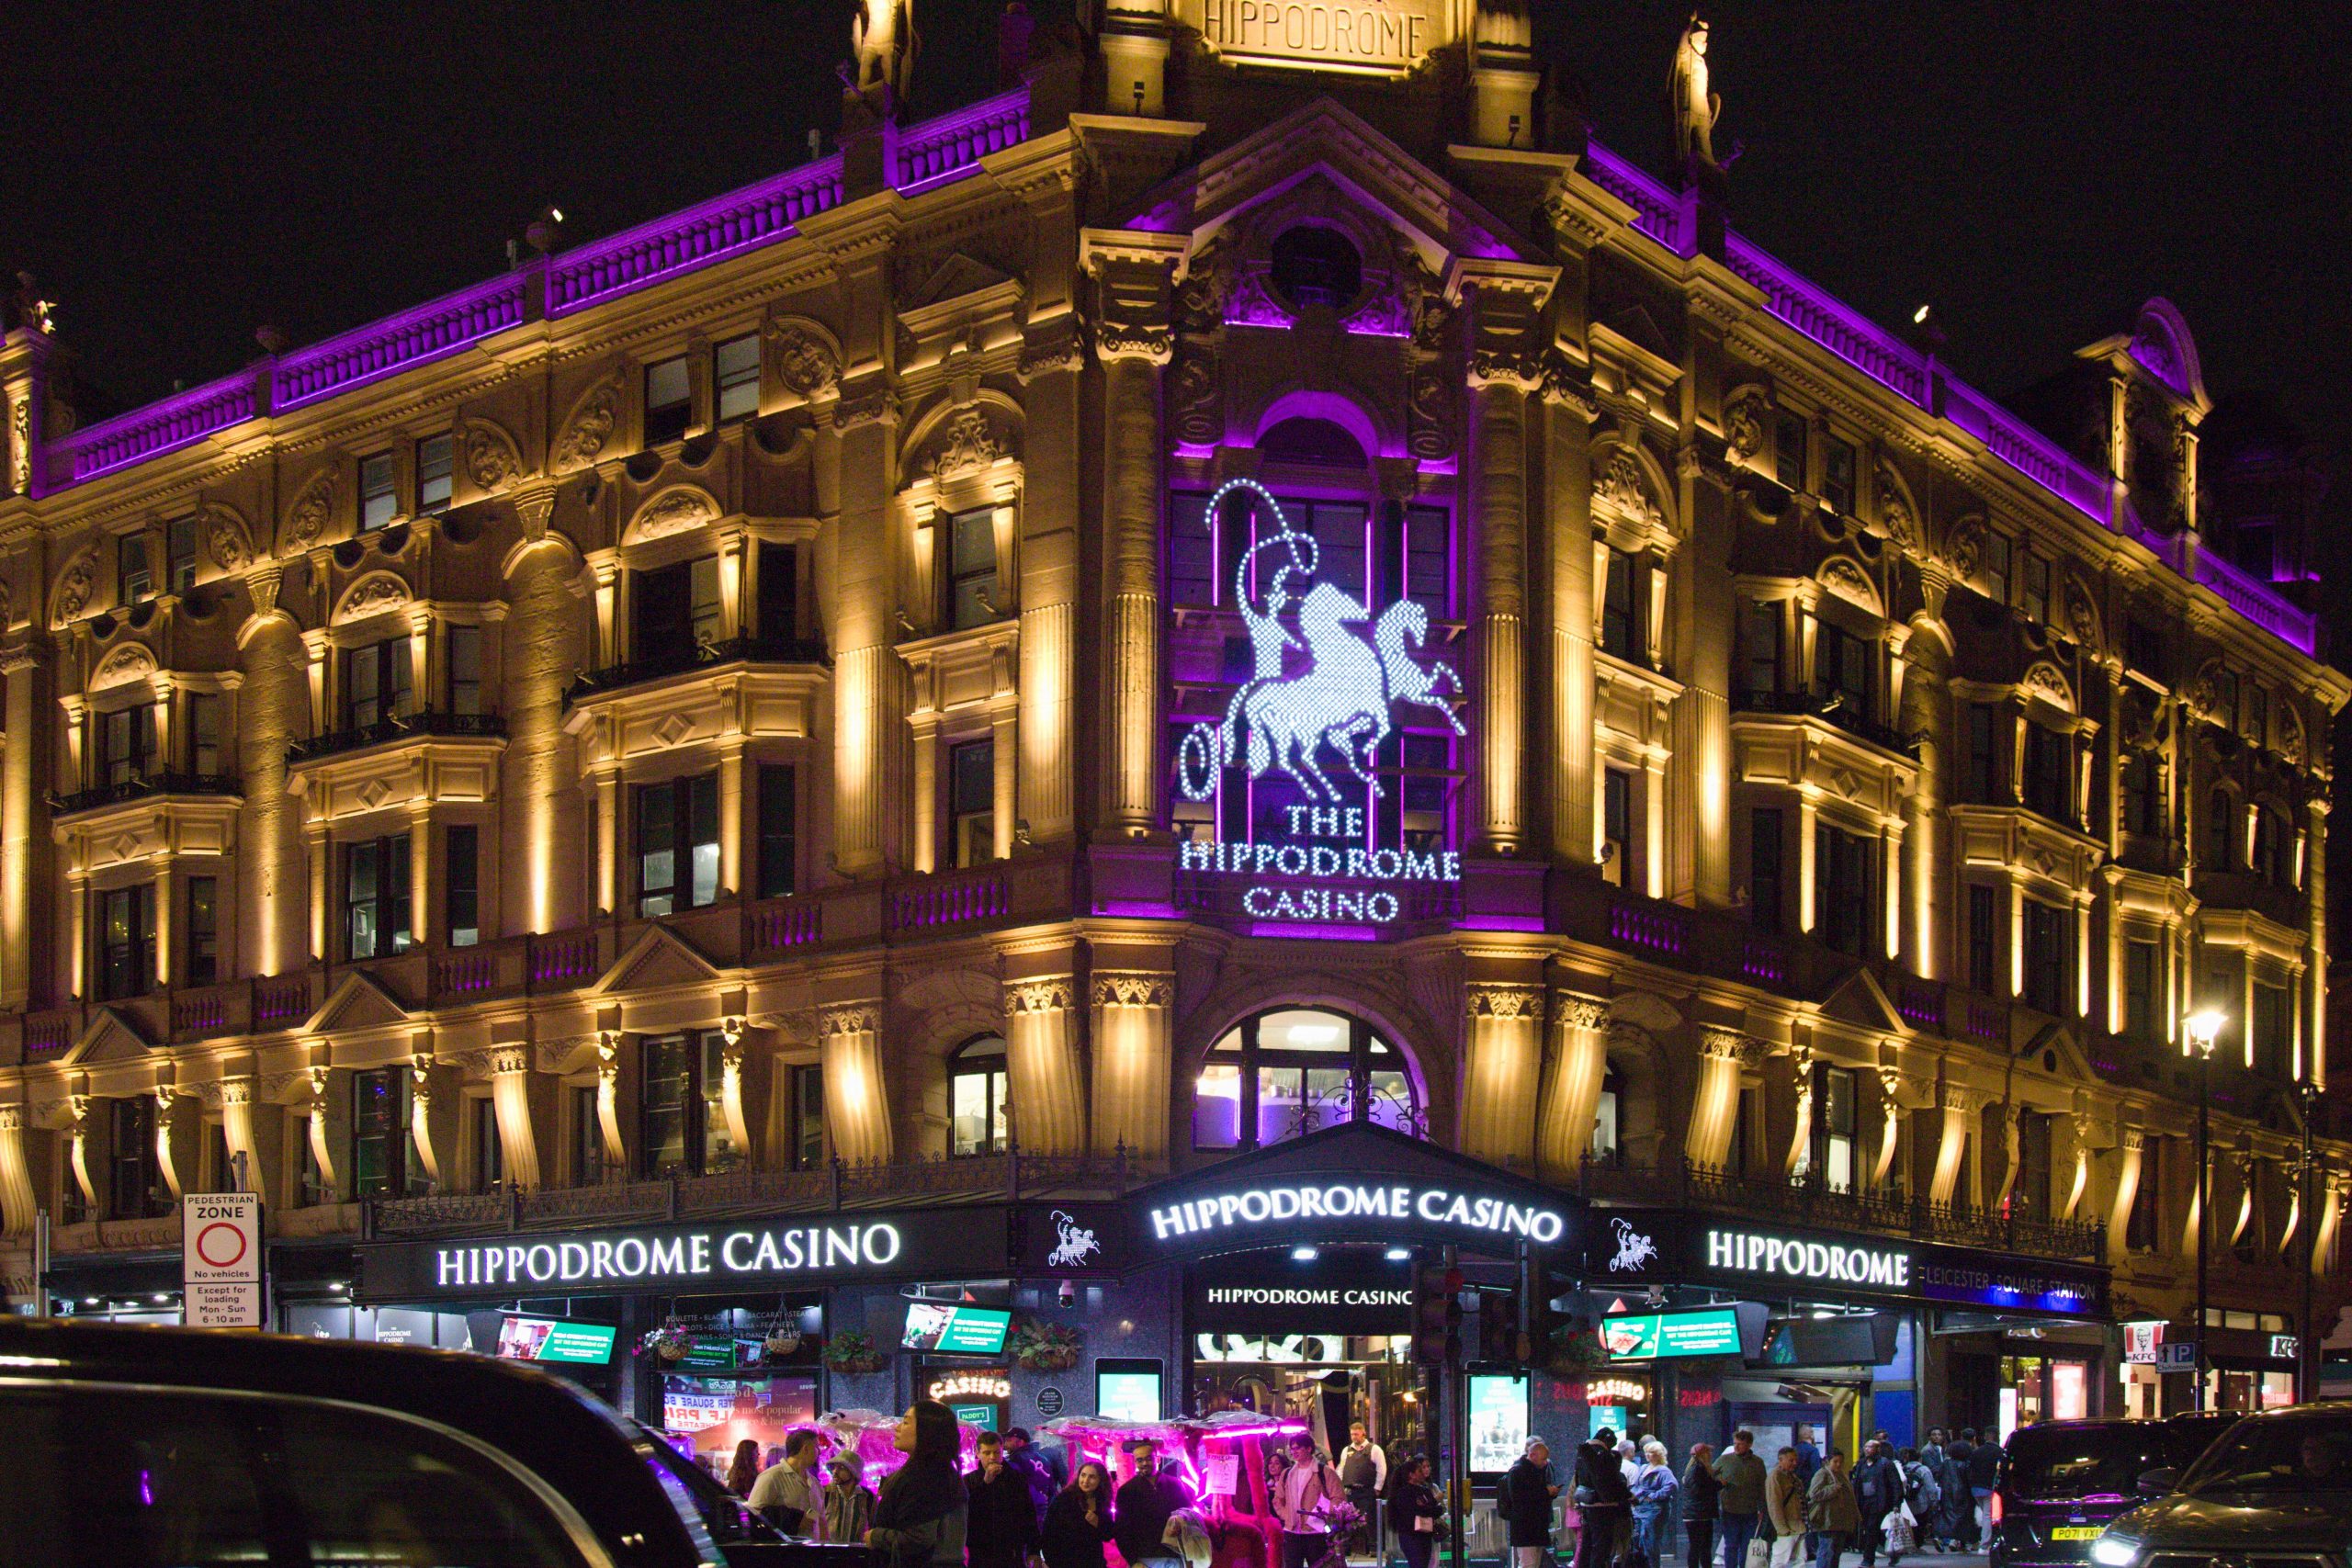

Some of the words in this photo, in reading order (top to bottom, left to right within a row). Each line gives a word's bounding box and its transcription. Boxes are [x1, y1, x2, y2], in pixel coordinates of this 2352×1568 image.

[1203, 0, 1428, 57] HIPPODROME
[1286, 805, 1363, 837] THE
[1180, 840, 1462, 881] HIPPODROME
[1243, 886, 1399, 922] CASINO
[188, 1196, 254, 1204] PEDESTRIAN
[197, 1207, 244, 1219] ZONE
[1151, 1185, 1410, 1239] HIPPODROME
[1418, 1190, 1563, 1242] CASINO
[436, 1234, 711, 1285] HIPPODROME
[722, 1223, 900, 1271] CASINO
[1708, 1230, 1909, 1287] HIPPODROME
[198, 1287, 230, 1295] Except
[1926, 1267, 1990, 1289] LEICESTER
[1996, 1274, 2043, 1295] SQUARE
[2050, 1280, 2097, 1300] STATION
[205, 1295, 240, 1303] loading
[1208, 1288, 1340, 1304] HIPPODROME
[665, 1314, 698, 1323] ROULETTE
[685, 1324, 704, 1332] LOTS
[708, 1323, 724, 1331] DICE
[2177, 1345, 2190, 1361] P
[929, 1377, 1011, 1399] CASINO
[1586, 1379, 1645, 1401] CASINO
[742, 1405, 764, 1415] most
[766, 1404, 803, 1416] popular
[961, 1411, 986, 1420] PADDY'S
